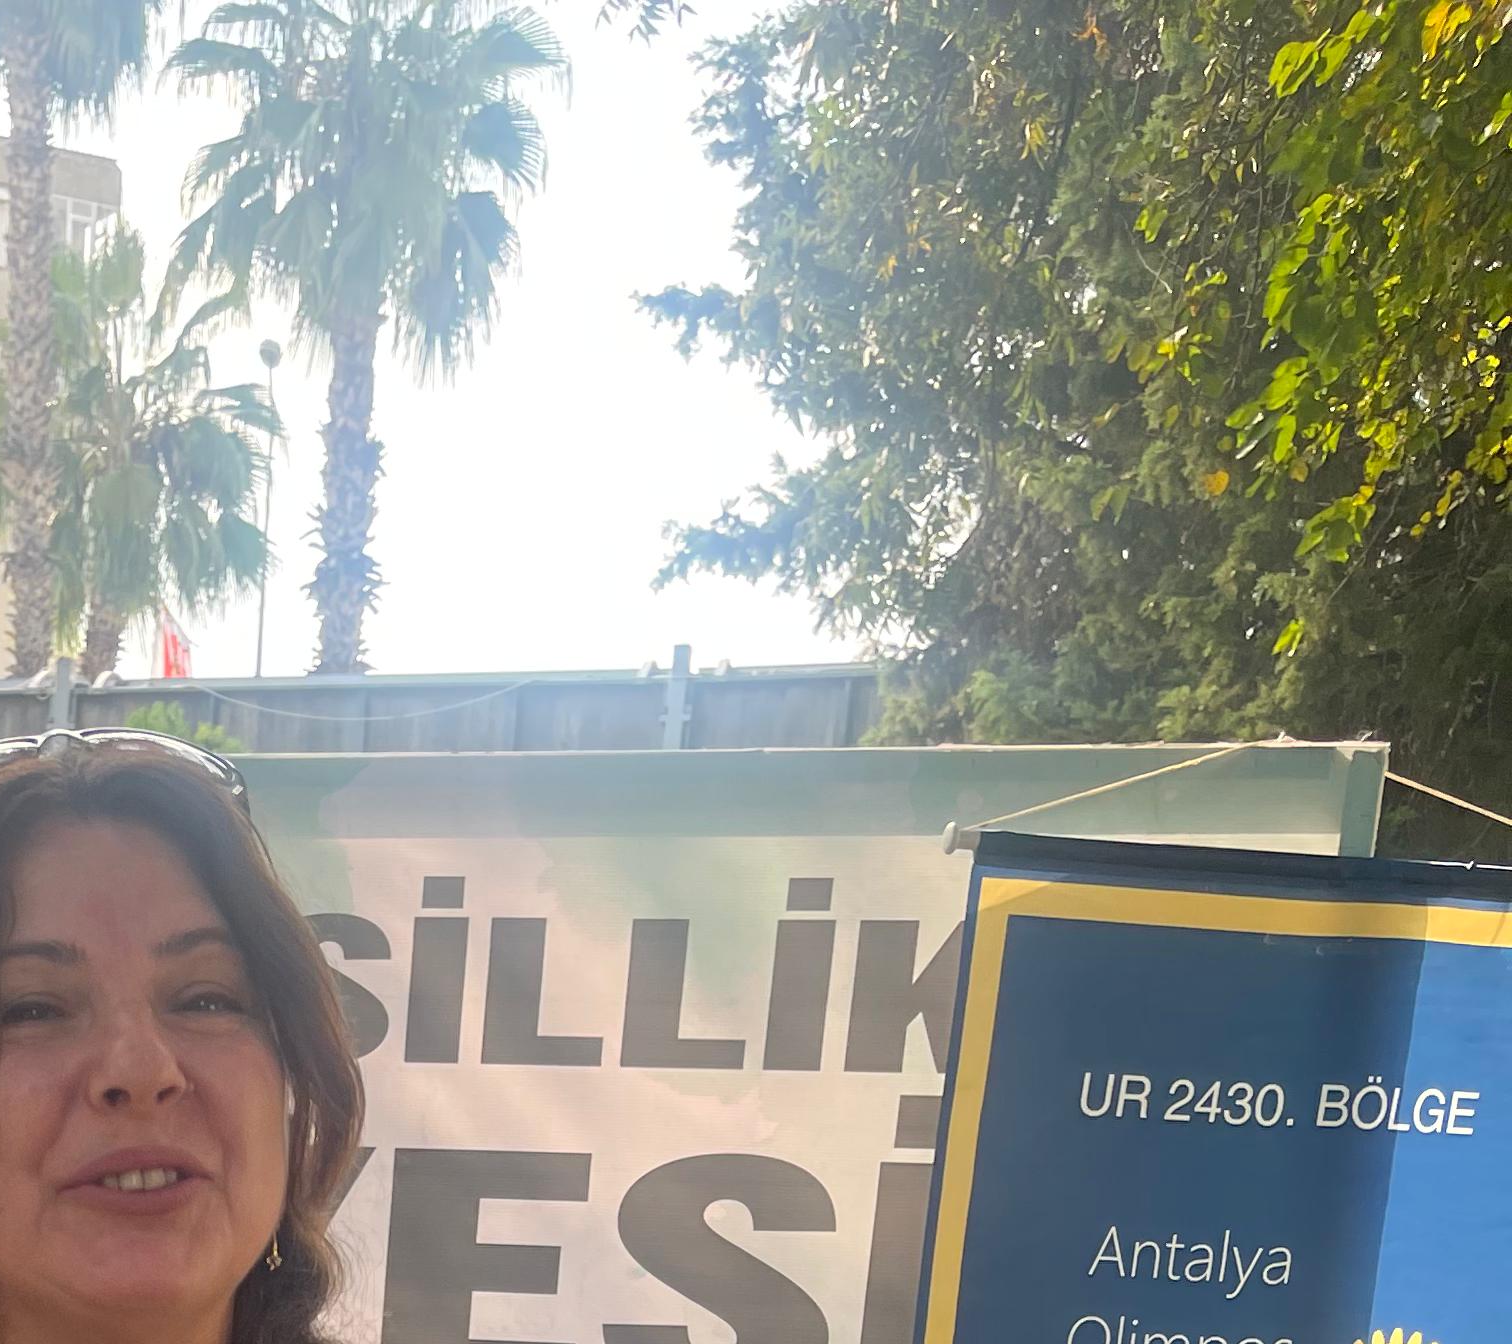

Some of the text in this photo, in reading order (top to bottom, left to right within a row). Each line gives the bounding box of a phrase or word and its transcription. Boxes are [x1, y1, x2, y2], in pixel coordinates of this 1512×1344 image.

[1079, 1072, 1480, 1137] UR 2430. BÖLGE
[1088, 1225, 1294, 1300] Antalya
